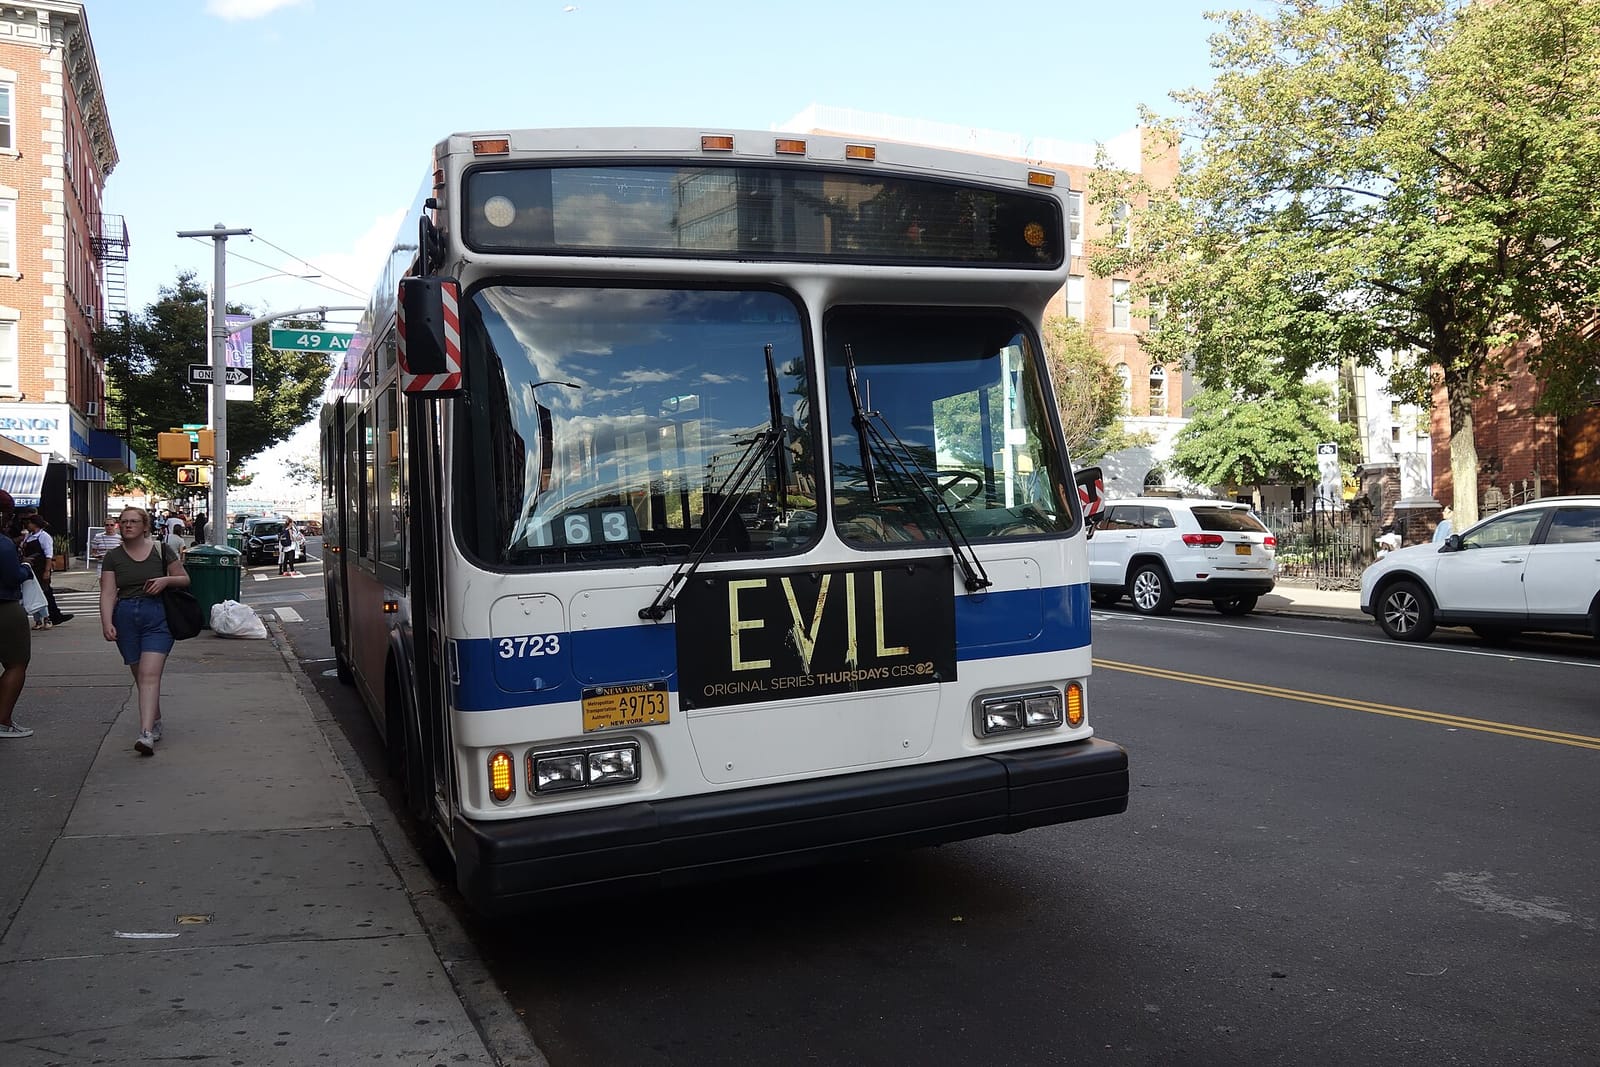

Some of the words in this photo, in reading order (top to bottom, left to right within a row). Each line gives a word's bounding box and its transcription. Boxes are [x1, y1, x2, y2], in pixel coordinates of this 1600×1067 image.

[297, 334, 321, 347] 49
[728, 570, 910, 674] EVIL
[499, 634, 561, 659] 3723
[603, 688, 623, 696] NEW
[626, 685, 648, 693] YORK
[703, 679, 768, 697] ORIGINAL
[771, 674, 815, 690] SERIES
[817, 667, 890, 685] THURSDAYS
